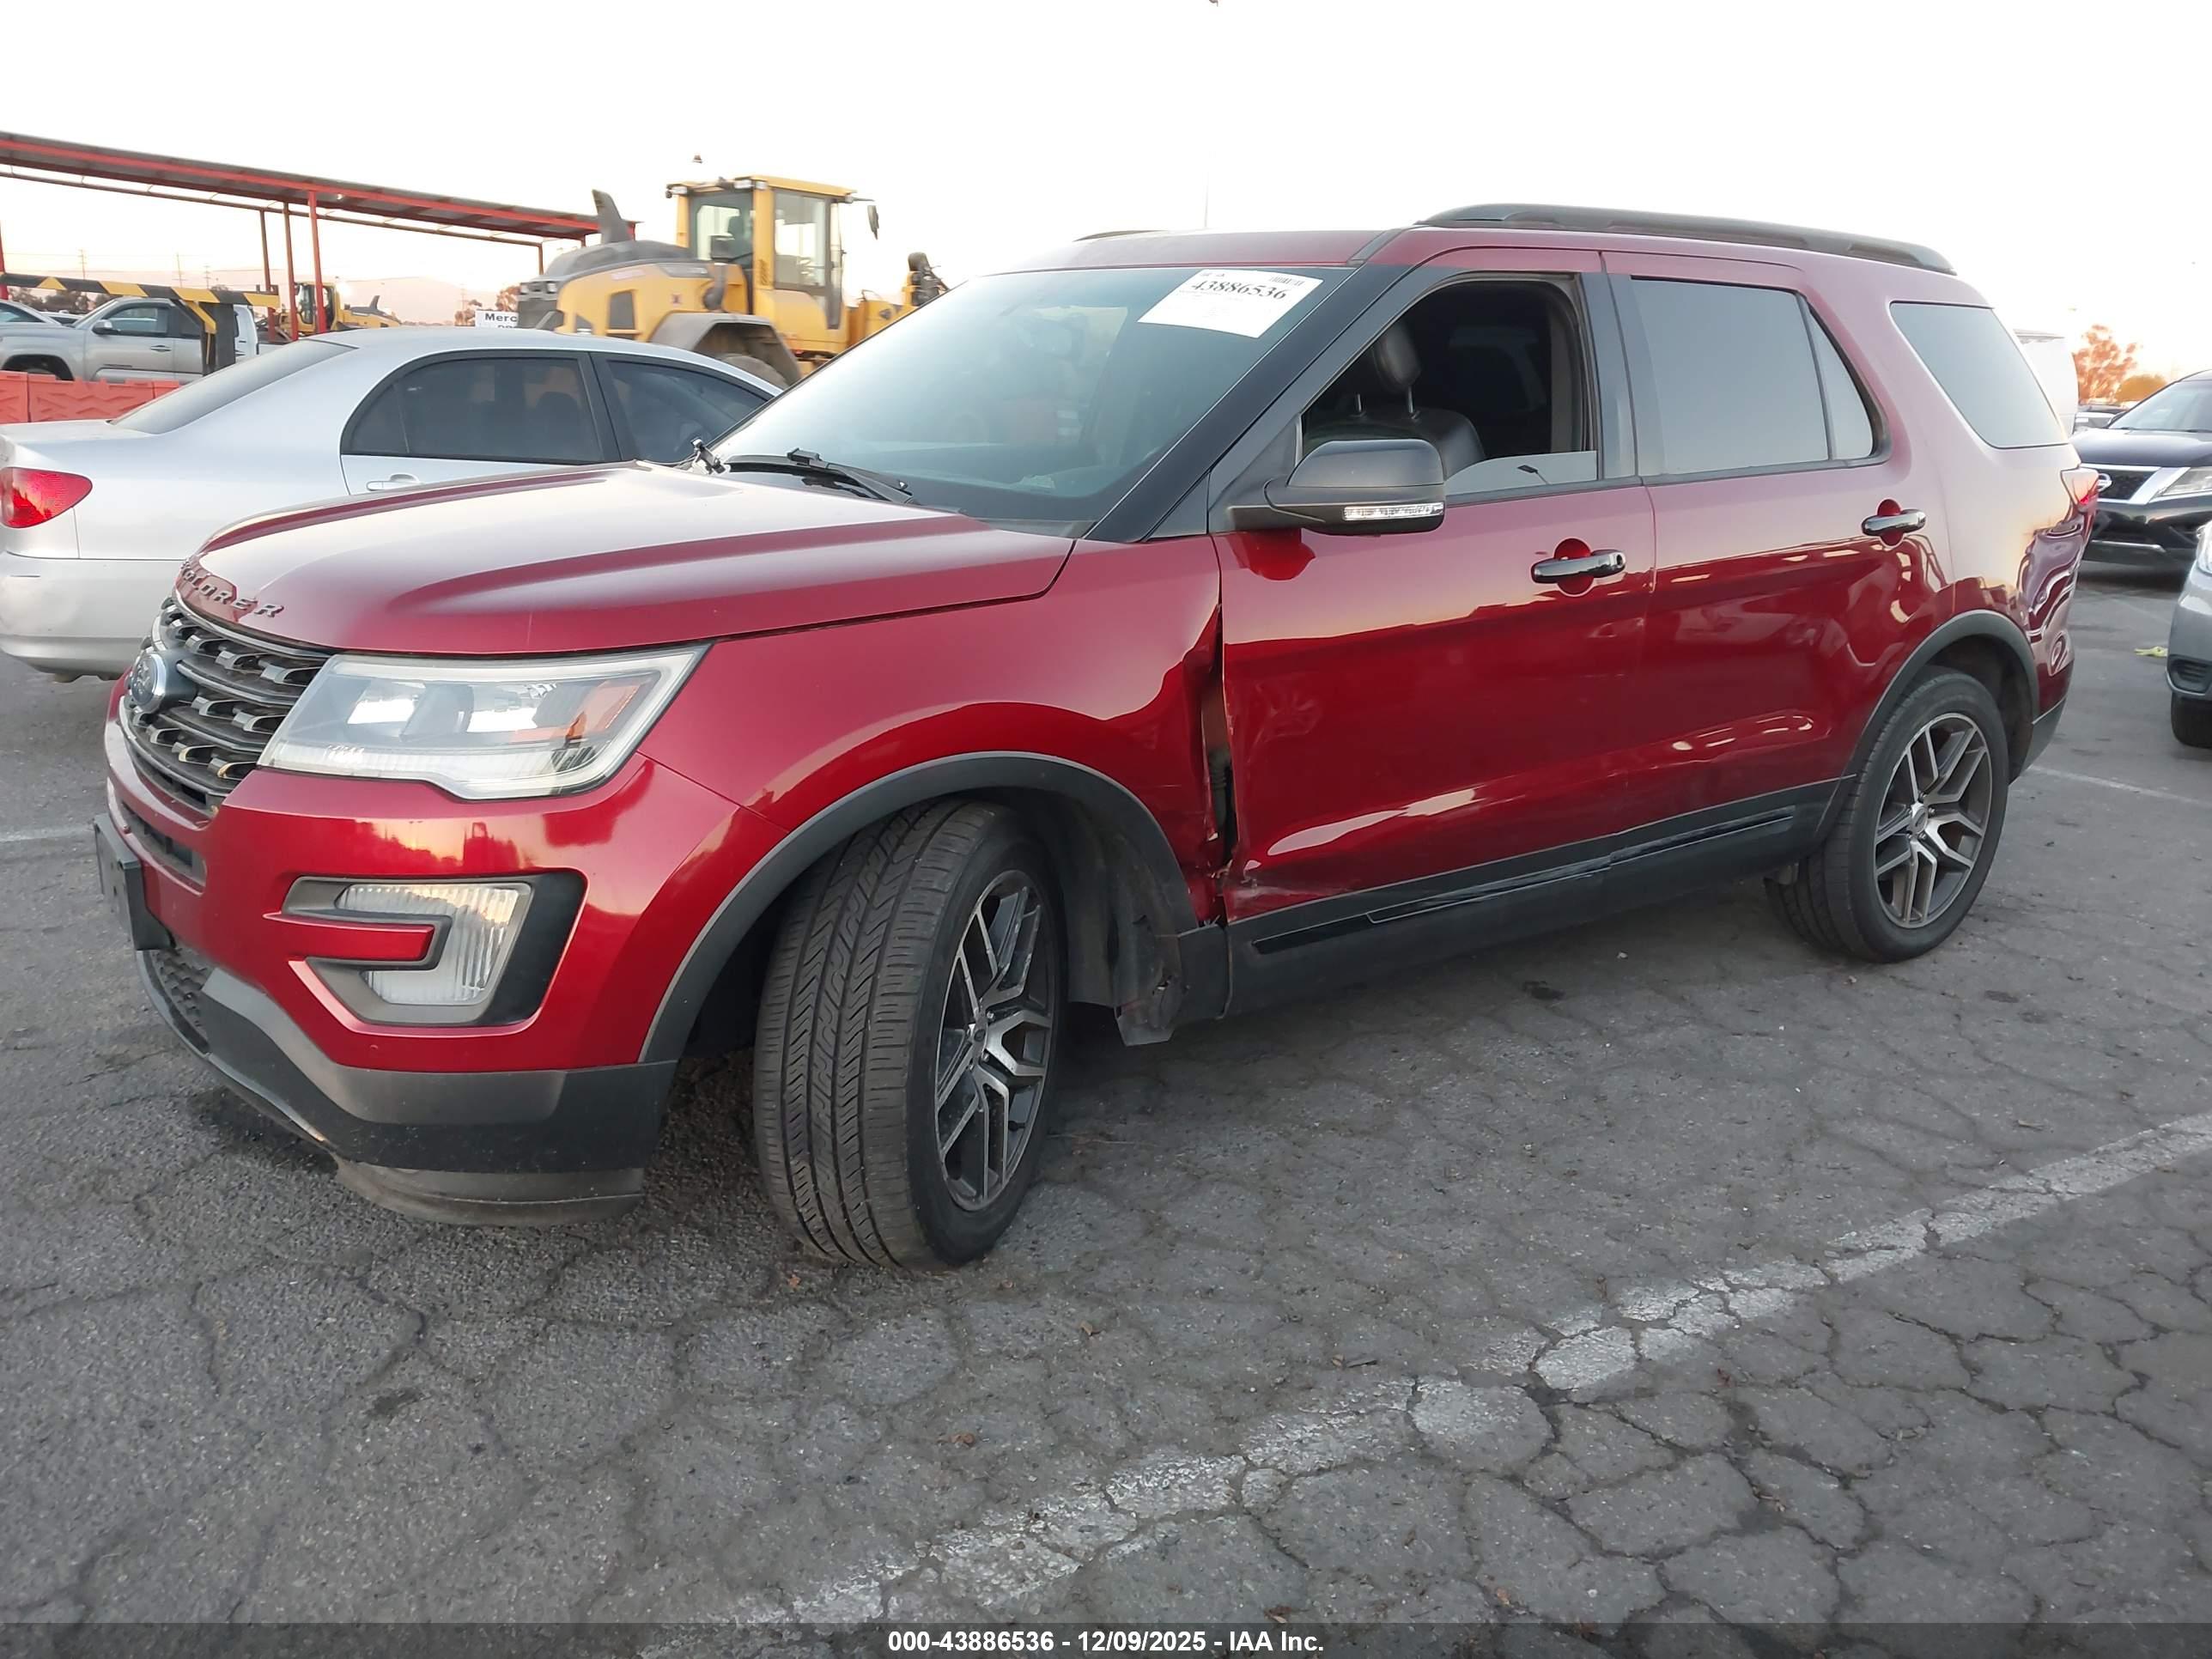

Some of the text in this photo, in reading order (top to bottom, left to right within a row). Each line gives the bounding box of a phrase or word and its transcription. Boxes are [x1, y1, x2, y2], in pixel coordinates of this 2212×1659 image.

[1191, 280, 1289, 300] 43886536
[484, 313, 518, 323] Merc
[180, 559, 285, 618] PLORER
